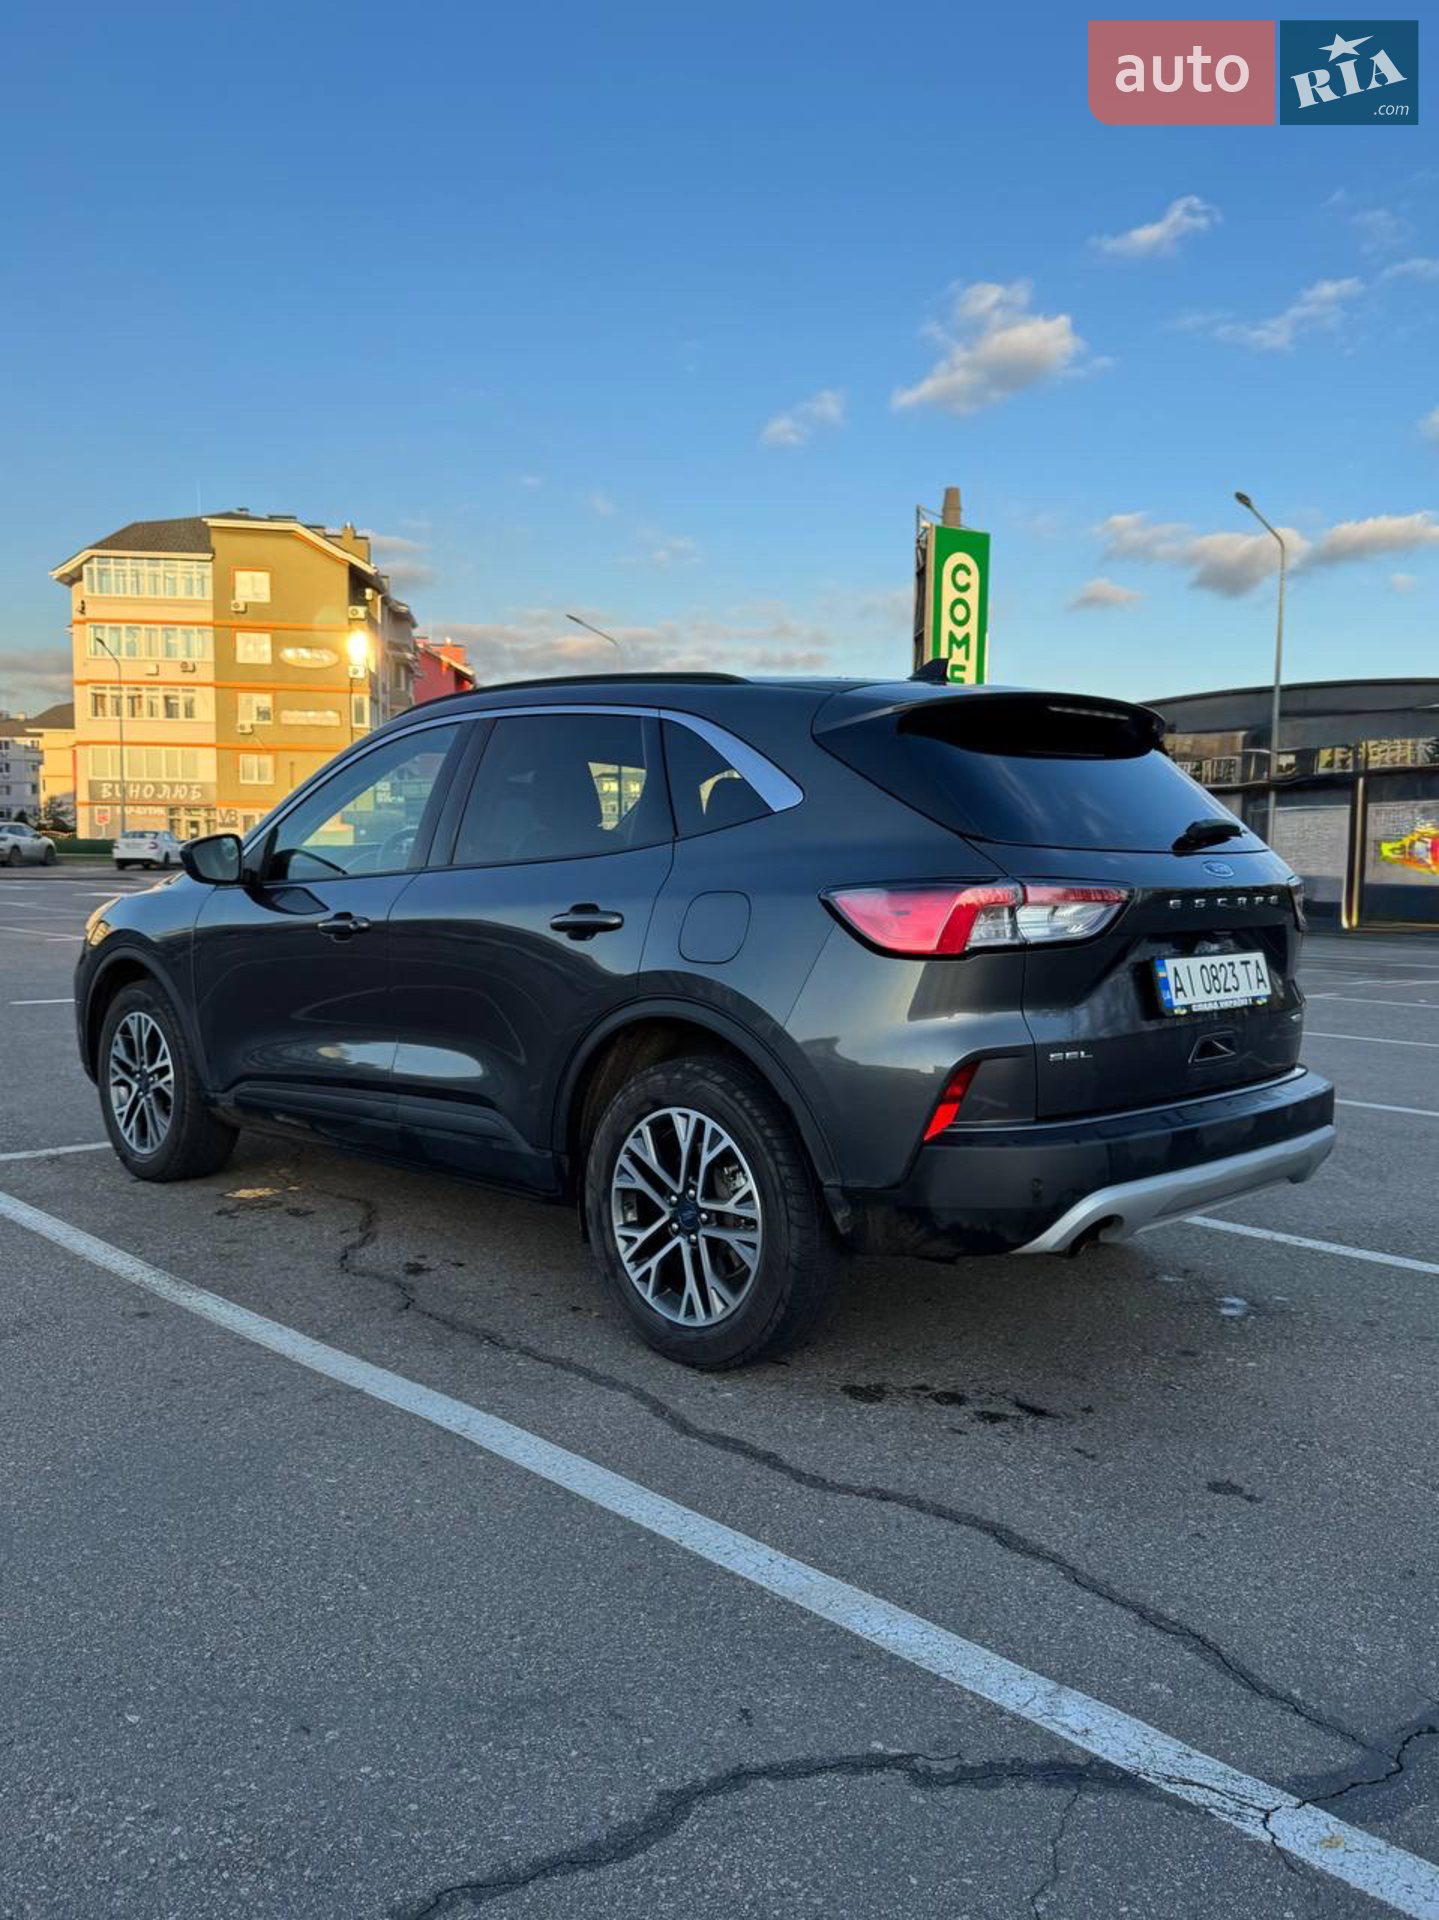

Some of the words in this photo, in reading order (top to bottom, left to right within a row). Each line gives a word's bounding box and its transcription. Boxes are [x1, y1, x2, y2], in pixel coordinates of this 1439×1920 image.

[1168, 894, 1279, 911] ESCAPE
[1173, 965, 1196, 999] AI
[1200, 961, 1240, 995] 0823
[1241, 959, 1268, 991] TA
[1049, 1050, 1094, 1062] SEL
